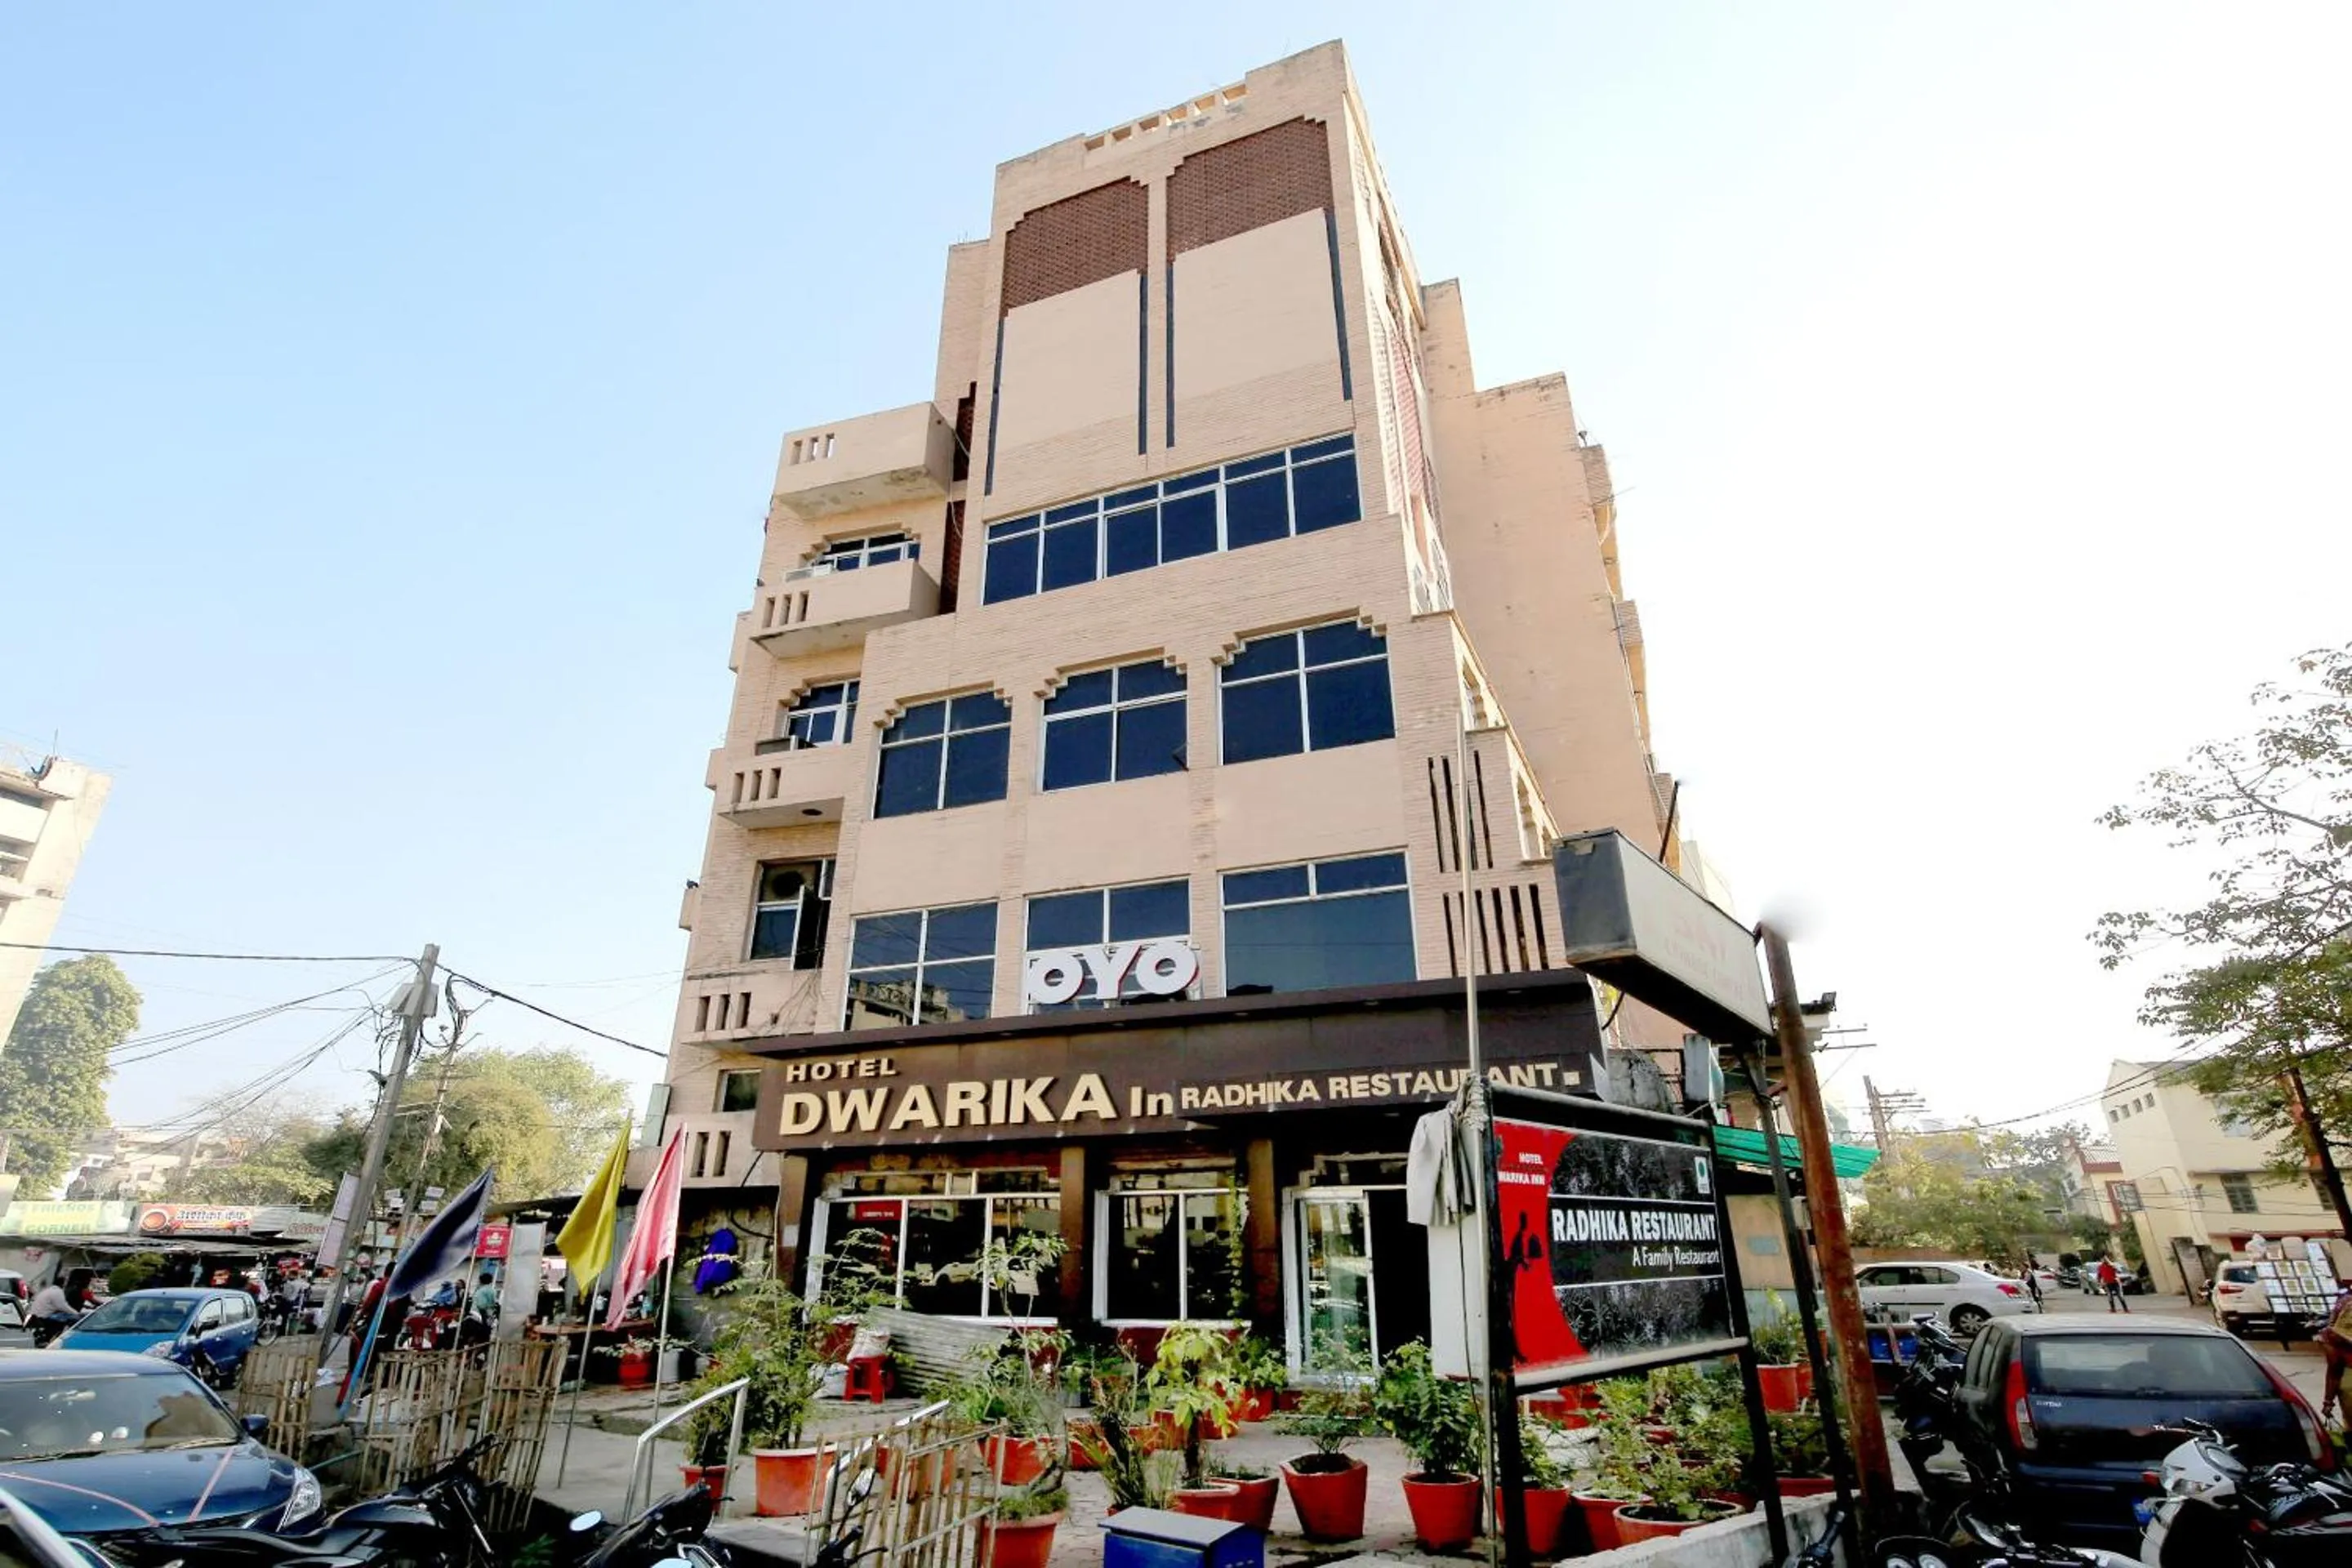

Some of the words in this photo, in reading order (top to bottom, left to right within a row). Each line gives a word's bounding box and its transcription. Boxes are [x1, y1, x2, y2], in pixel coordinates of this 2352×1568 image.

[1027, 940, 1200, 1004] OYO
[786, 1058, 898, 1083] HOTEL
[779, 1072, 1119, 1136] DWARIKA
[1131, 1085, 1174, 1118] In
[1181, 1078, 1320, 1111] RADHIKA
[1552, 1209, 1629, 1241] RADHIKA
[1631, 1211, 1716, 1241] RESTAURANT
[1633, 1246, 1642, 1267] A
[1642, 1245, 1673, 1272] Family
[1674, 1245, 1720, 1266] Restaurant
